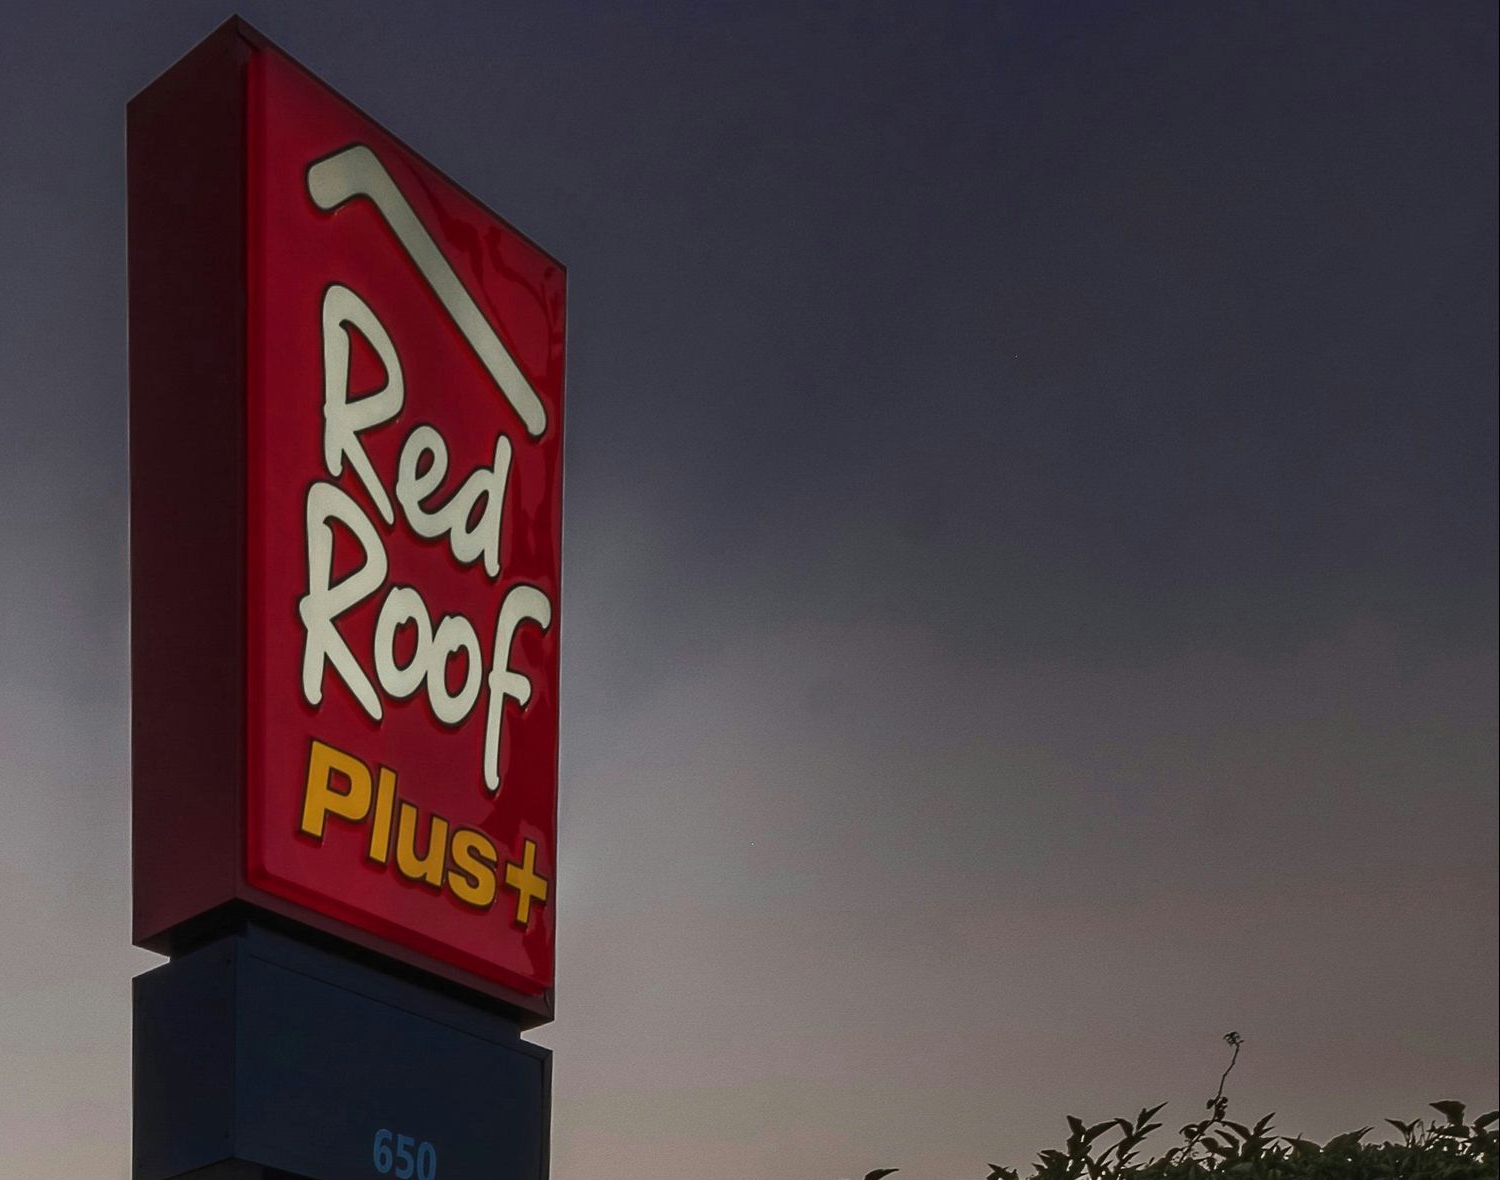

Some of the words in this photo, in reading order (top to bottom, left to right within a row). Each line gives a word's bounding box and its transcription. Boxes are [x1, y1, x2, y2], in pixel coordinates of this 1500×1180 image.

[321, 283, 512, 578] Red
[299, 481, 552, 793] Roof
[299, 738, 549, 925] Plus+
